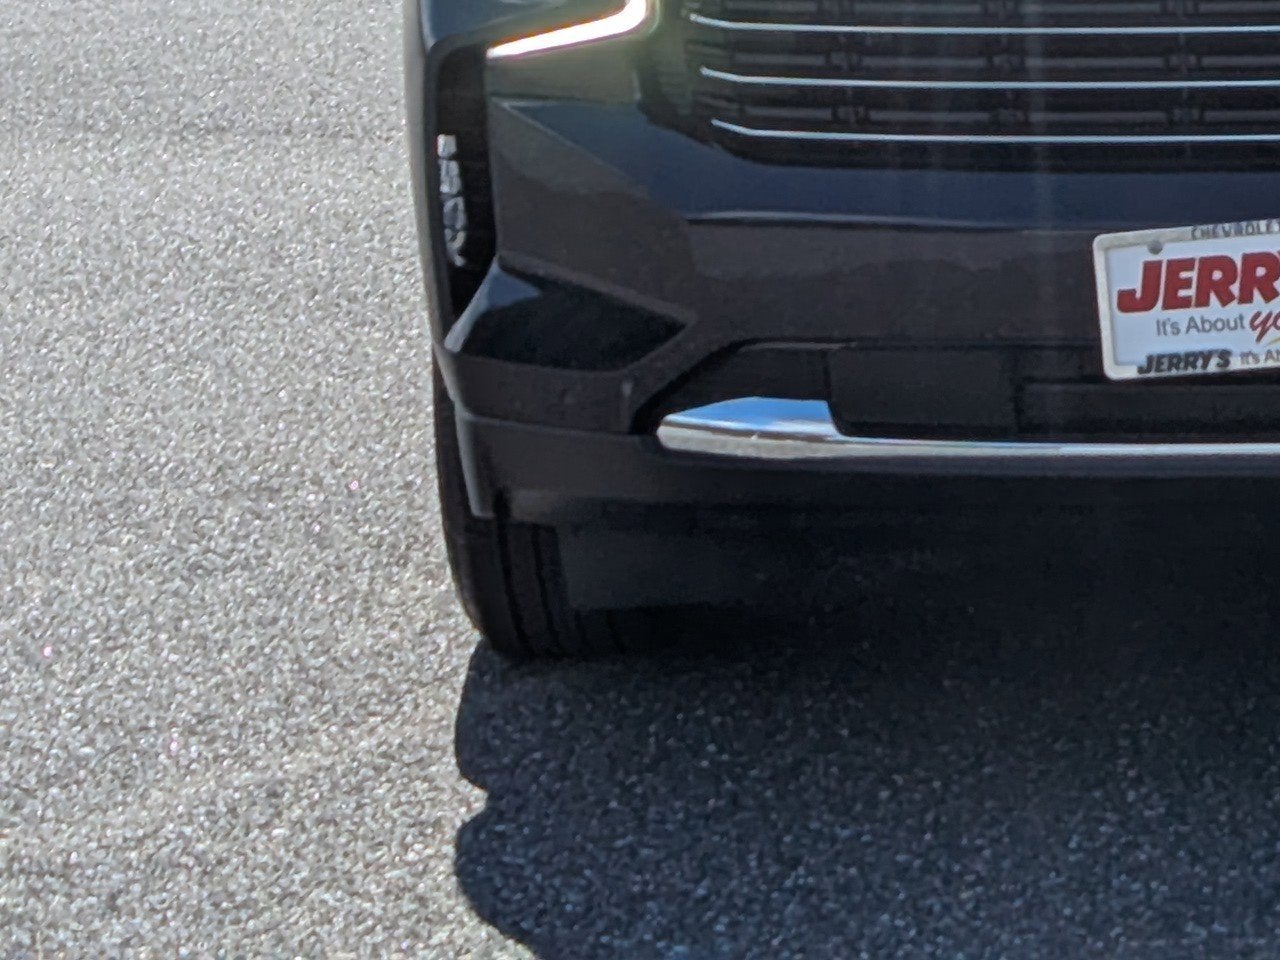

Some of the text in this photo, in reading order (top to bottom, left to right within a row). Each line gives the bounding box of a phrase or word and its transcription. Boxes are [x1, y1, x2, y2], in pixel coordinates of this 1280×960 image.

[1156, 318, 1181, 336] It's
[1186, 313, 1245, 335] About
[1137, 348, 1233, 375] JERRY'S
[1240, 350, 1260, 366] It's
